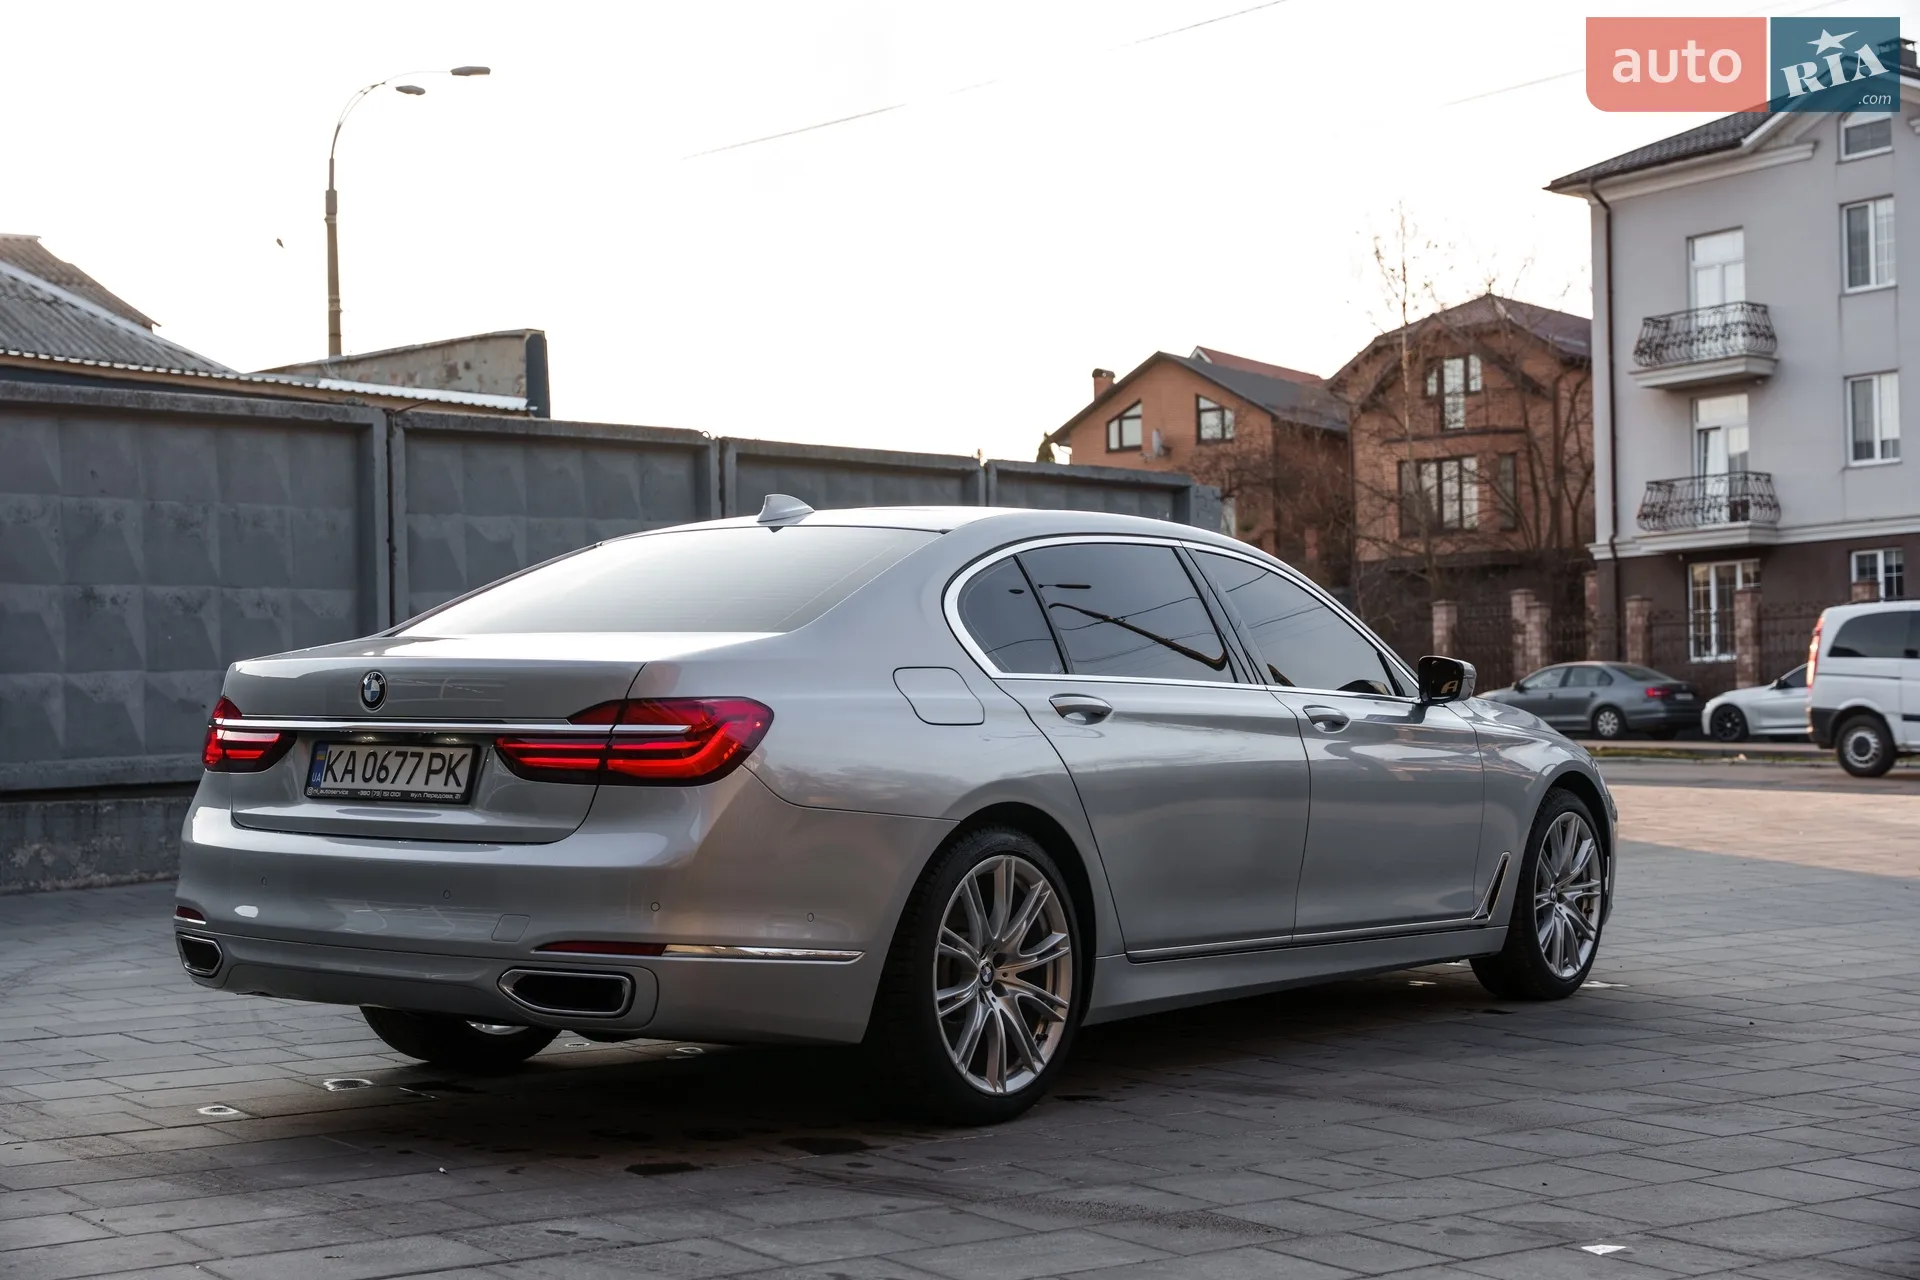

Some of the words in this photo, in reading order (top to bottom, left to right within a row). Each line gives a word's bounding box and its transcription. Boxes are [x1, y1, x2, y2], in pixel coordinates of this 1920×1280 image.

[311, 772, 321, 782] UA
[323, 750, 356, 783] KA
[361, 751, 424, 785] 0677
[424, 752, 469, 787] PK
